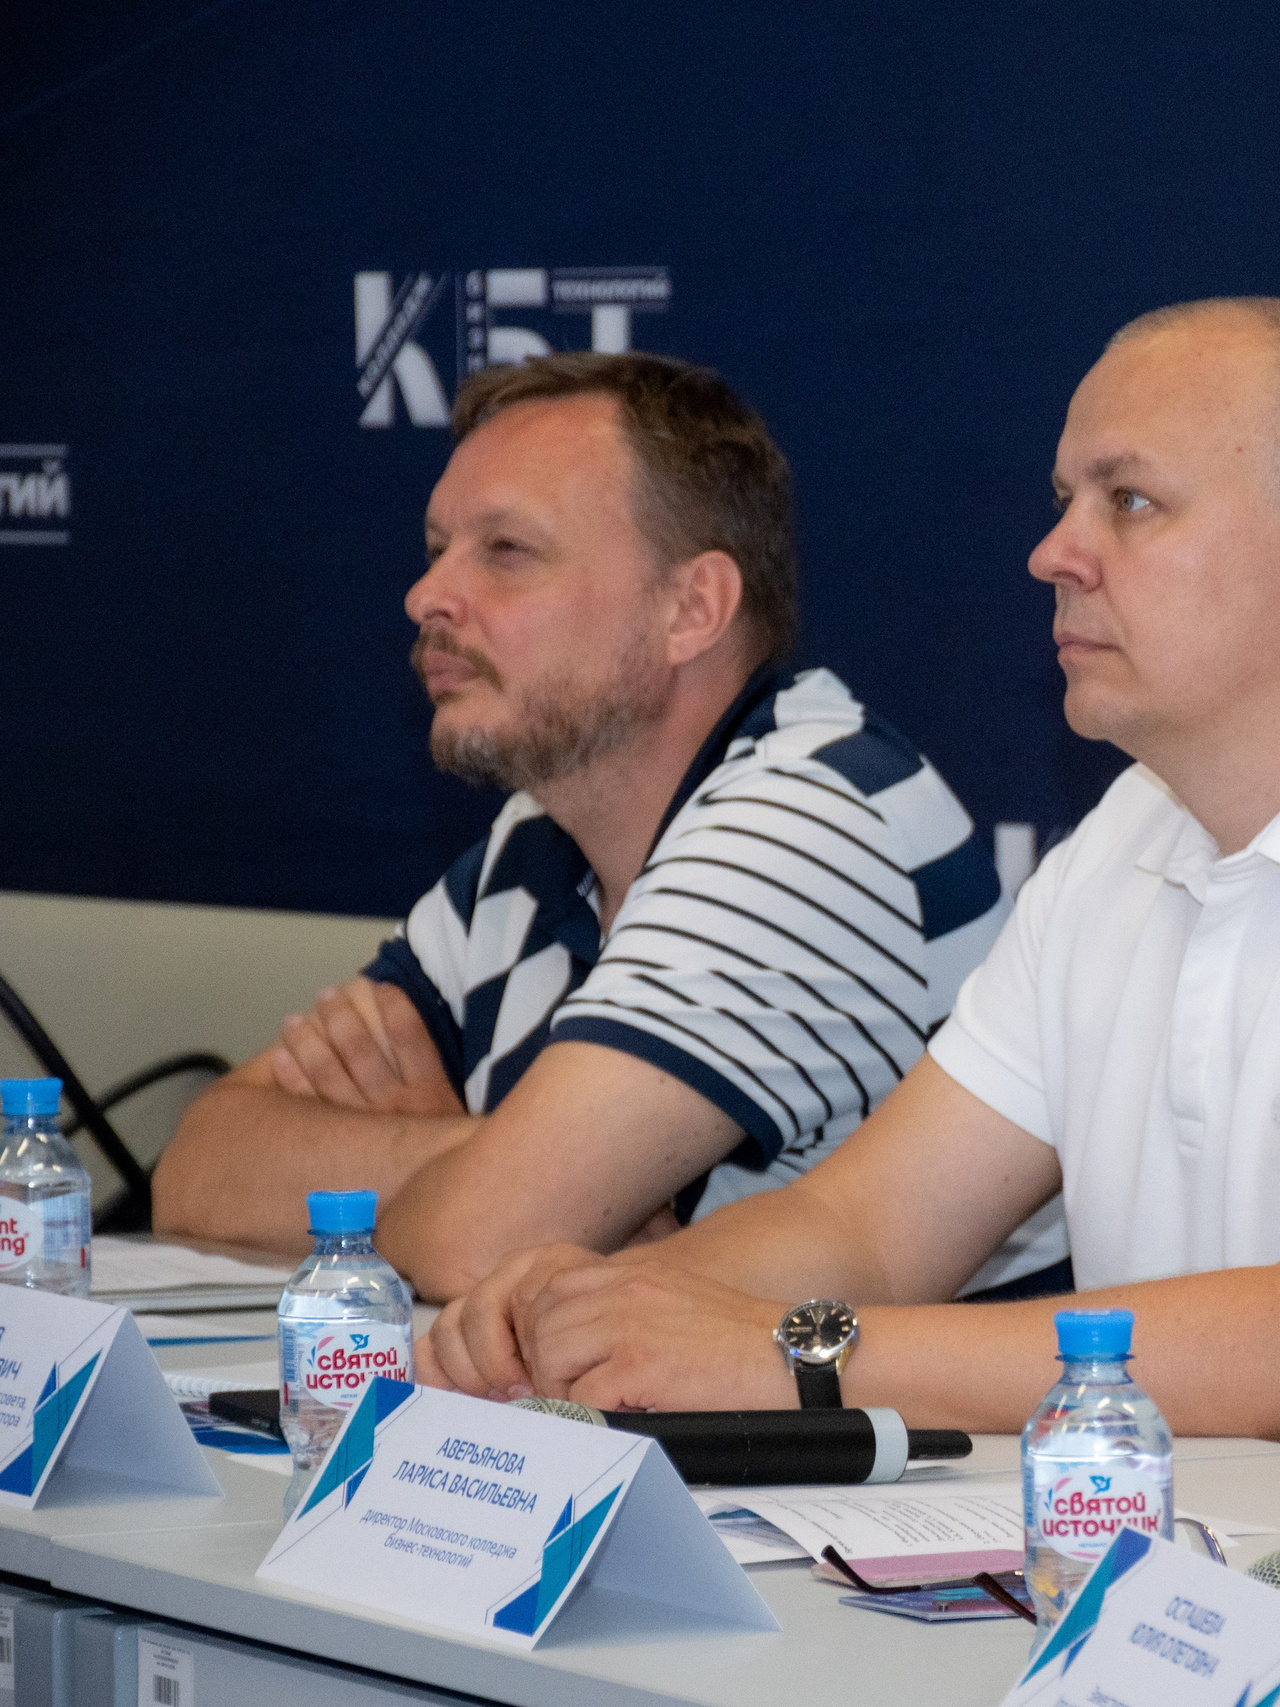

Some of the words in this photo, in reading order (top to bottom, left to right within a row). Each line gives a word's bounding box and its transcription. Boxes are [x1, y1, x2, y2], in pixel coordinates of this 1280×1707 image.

[306, 1367, 406, 1390] истоик
[436, 1437, 526, 1476] АВЕРЬЯНОВА
[392, 1460, 450, 1492] ЛАРИСА
[447, 1473, 538, 1514] ВАСИЛЬЕВНА
[359, 1509, 409, 1531] директор
[407, 1516, 469, 1547] Московского
[468, 1535, 518, 1560] колледжа
[383, 1532, 474, 1569] бизнес-технологий
